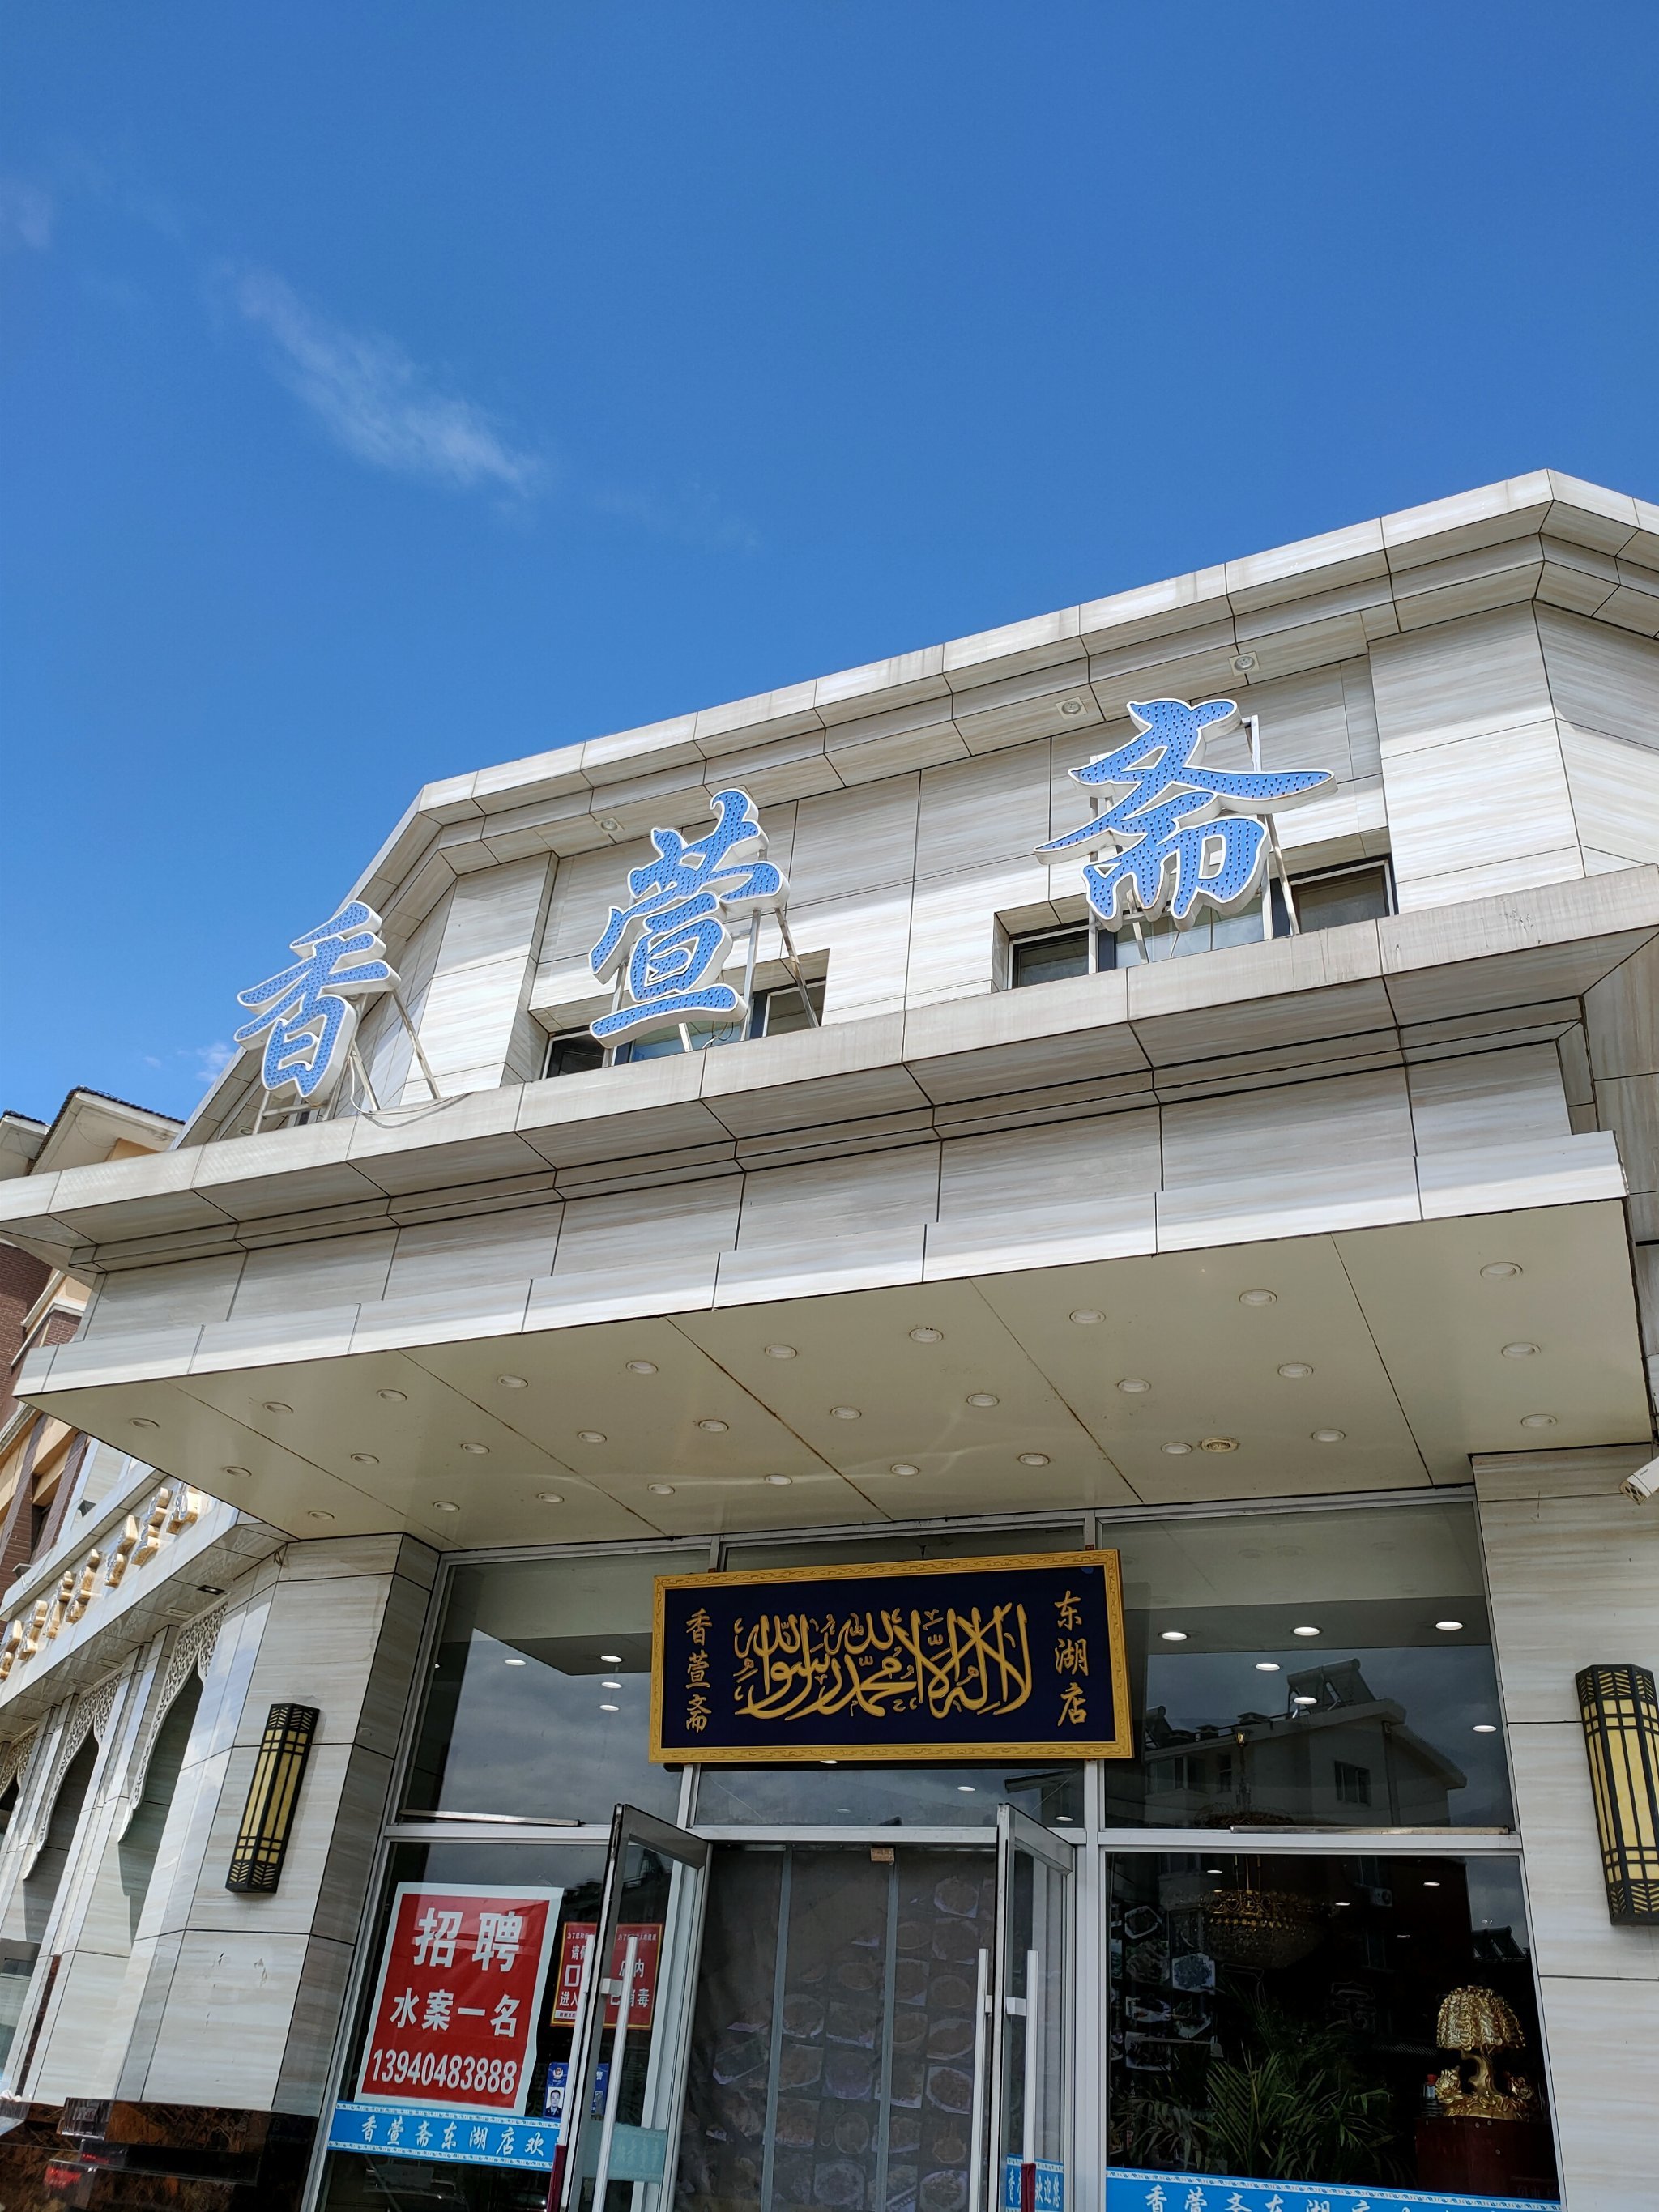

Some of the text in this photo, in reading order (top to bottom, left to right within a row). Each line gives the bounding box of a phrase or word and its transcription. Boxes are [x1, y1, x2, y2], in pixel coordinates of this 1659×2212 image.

[685, 1607, 714, 1733] 香萱斋
[1054, 1590, 1090, 1727] 东湖店
[413, 1907, 522, 1972] 招聘
[390, 1987, 521, 2038] 水案一名
[373, 2048, 518, 2095] 13940483888
[361, 2114, 559, 2157] 香萱斋东湖店欢
